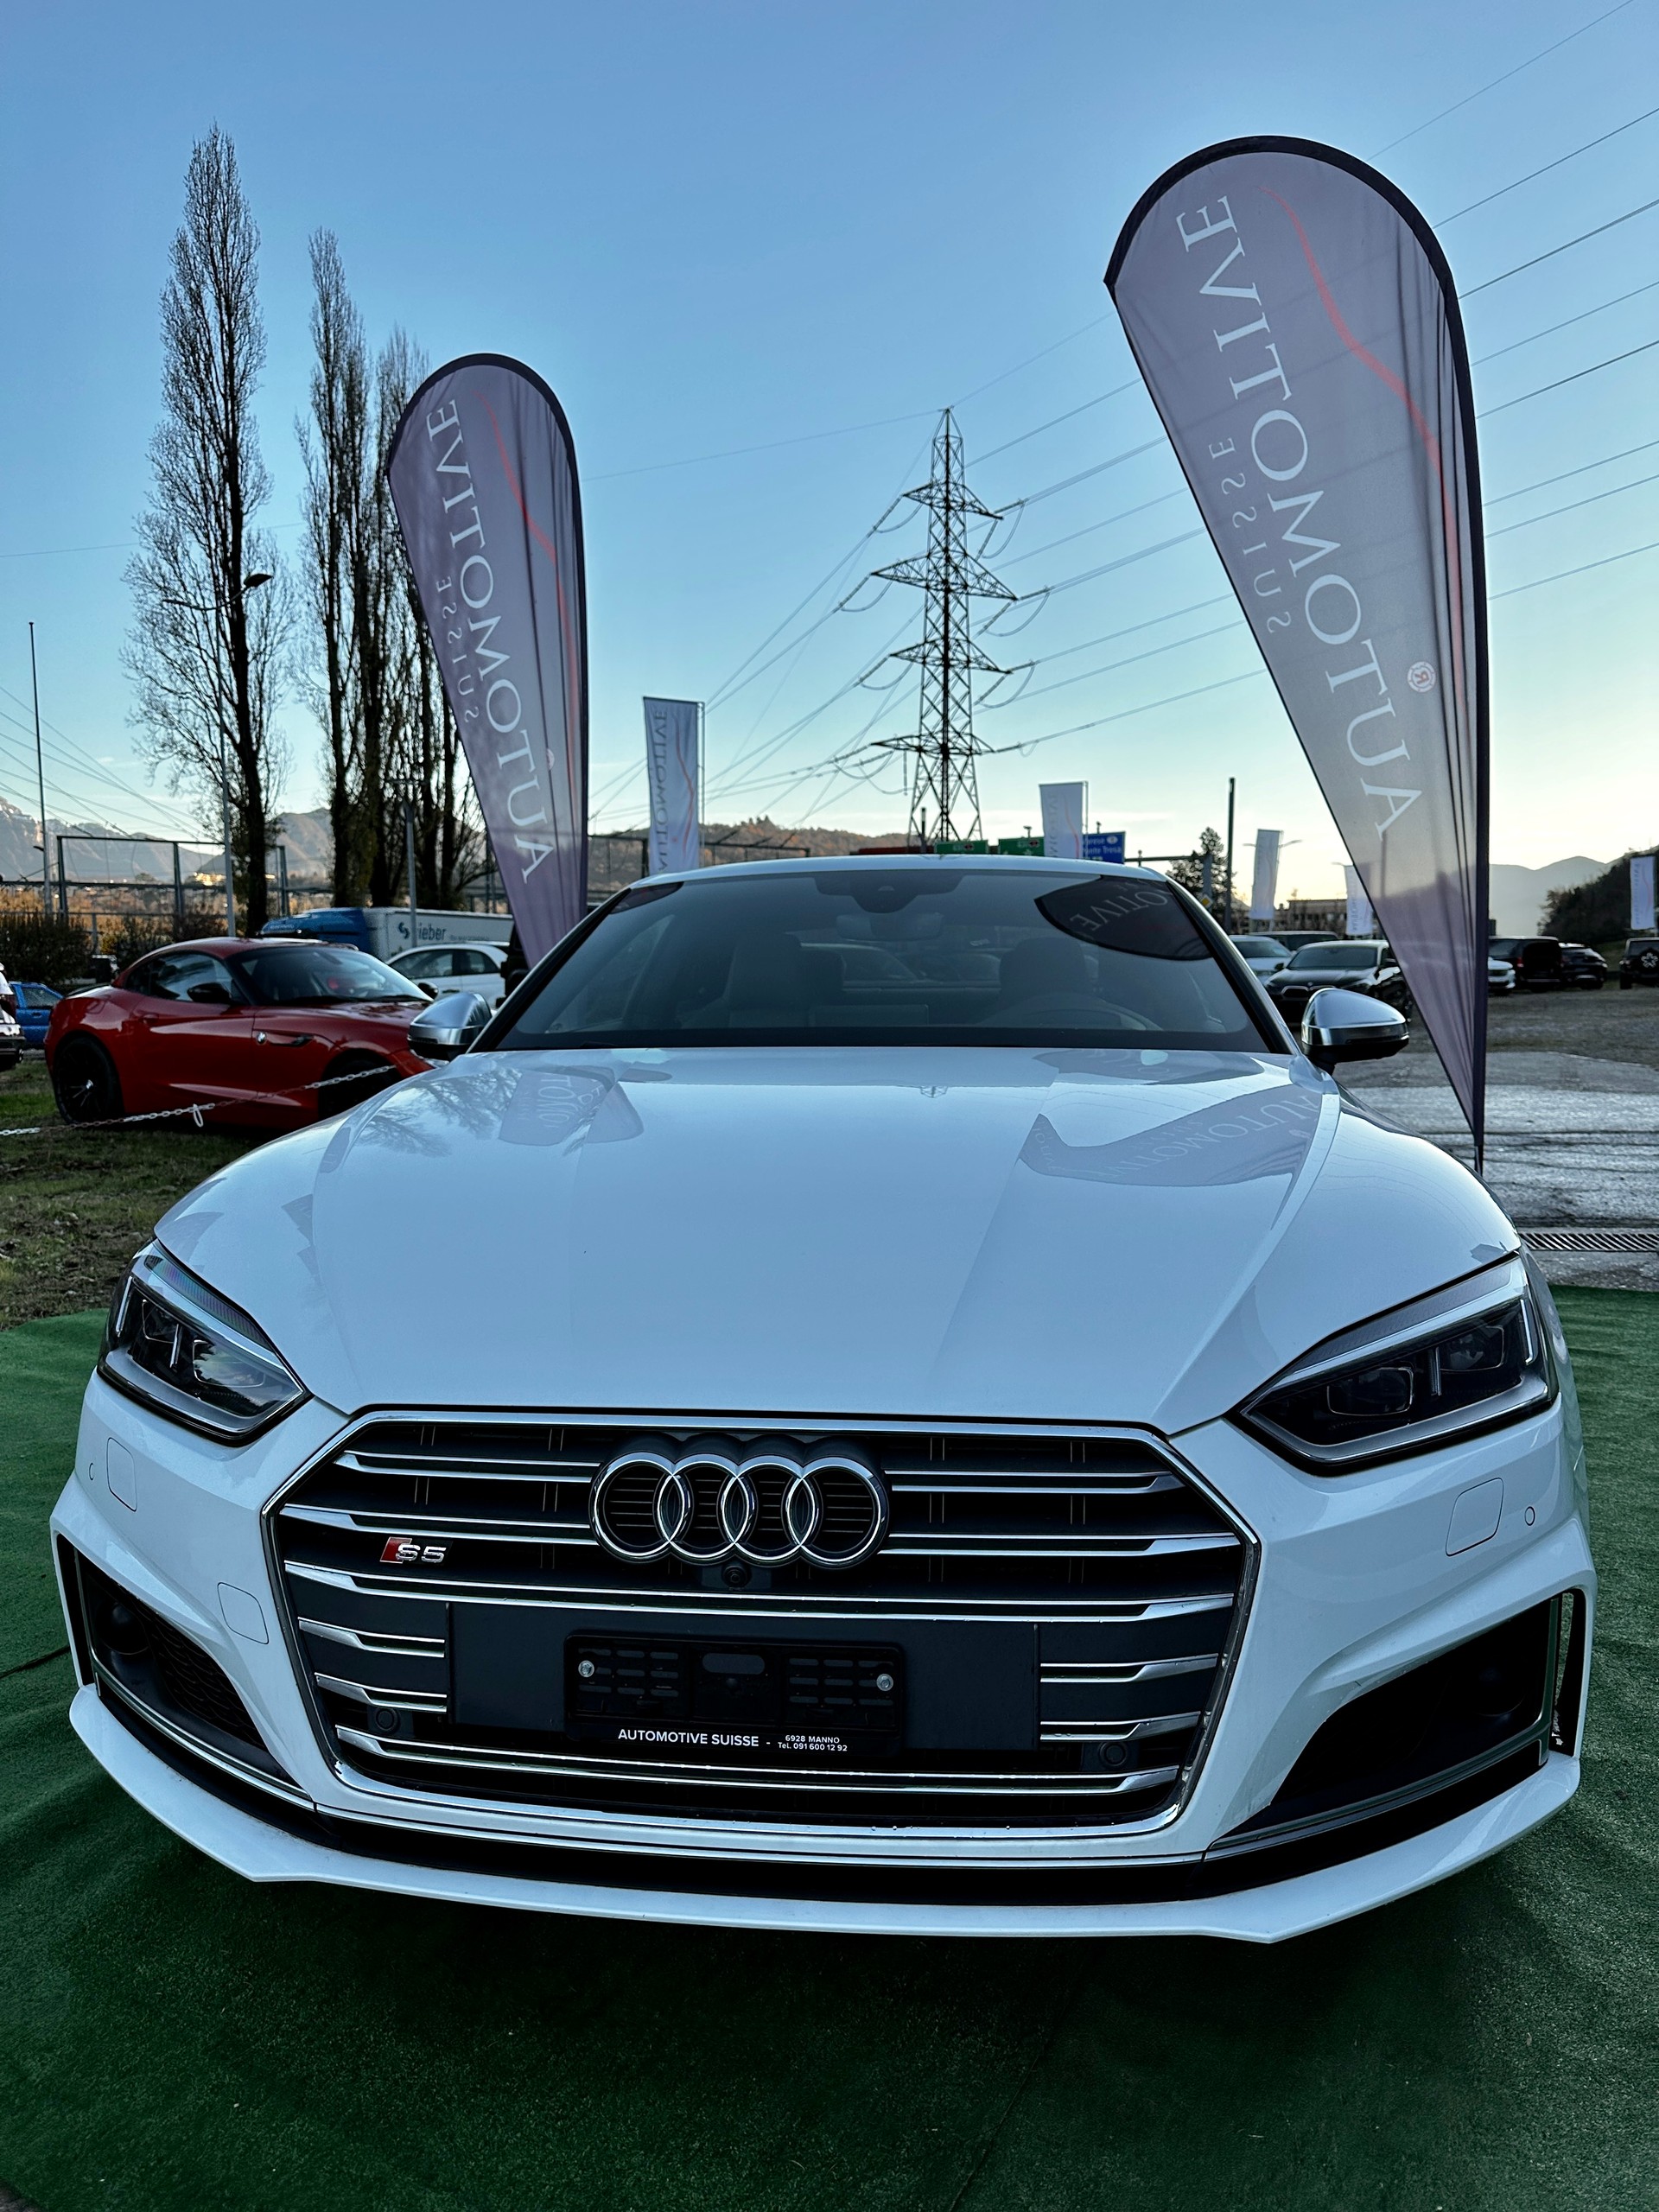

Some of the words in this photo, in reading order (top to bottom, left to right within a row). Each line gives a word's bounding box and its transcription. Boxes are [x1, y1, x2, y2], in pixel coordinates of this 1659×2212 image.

[412, 923, 446, 940] ieber
[395, 1542, 447, 1563] S5
[618, 1728, 708, 1744] AUTOMOTIVE
[711, 1734, 760, 1747] SUISSE
[778, 1741, 791, 1750] Tel.
[793, 1742, 809, 1751] 091
[785, 1734, 806, 1743] 6928
[808, 1735, 840, 1744] MANNO
